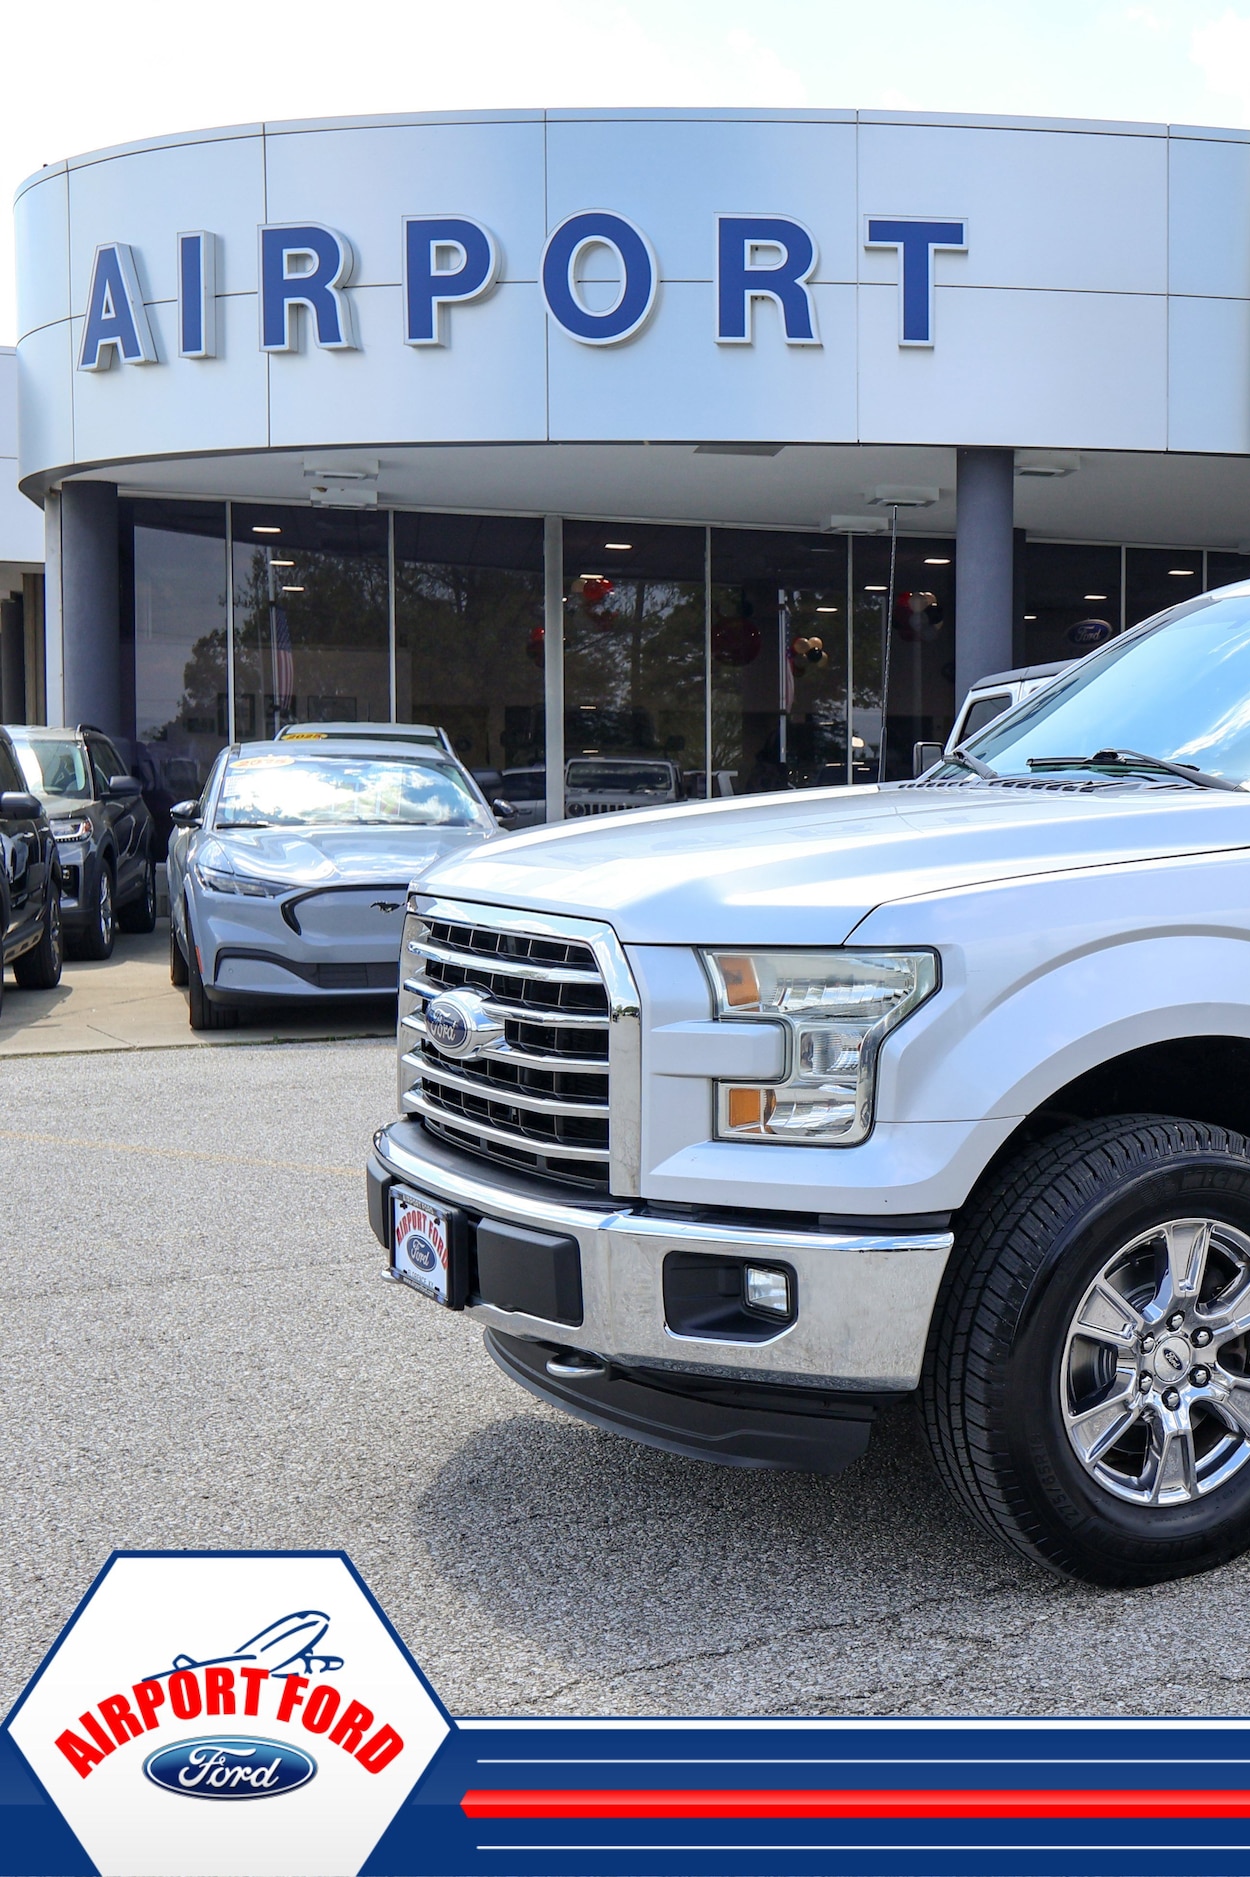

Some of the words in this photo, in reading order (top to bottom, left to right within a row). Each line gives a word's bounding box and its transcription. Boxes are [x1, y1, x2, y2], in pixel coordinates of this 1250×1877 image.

[77, 207, 969, 373] AIRPORT
[1075, 625, 1102, 641] Ford
[430, 1008, 457, 1041] Ford
[395, 1210, 427, 1247] AIRPORT
[428, 1220, 449, 1271] FORD
[410, 1239, 430, 1267] Ford
